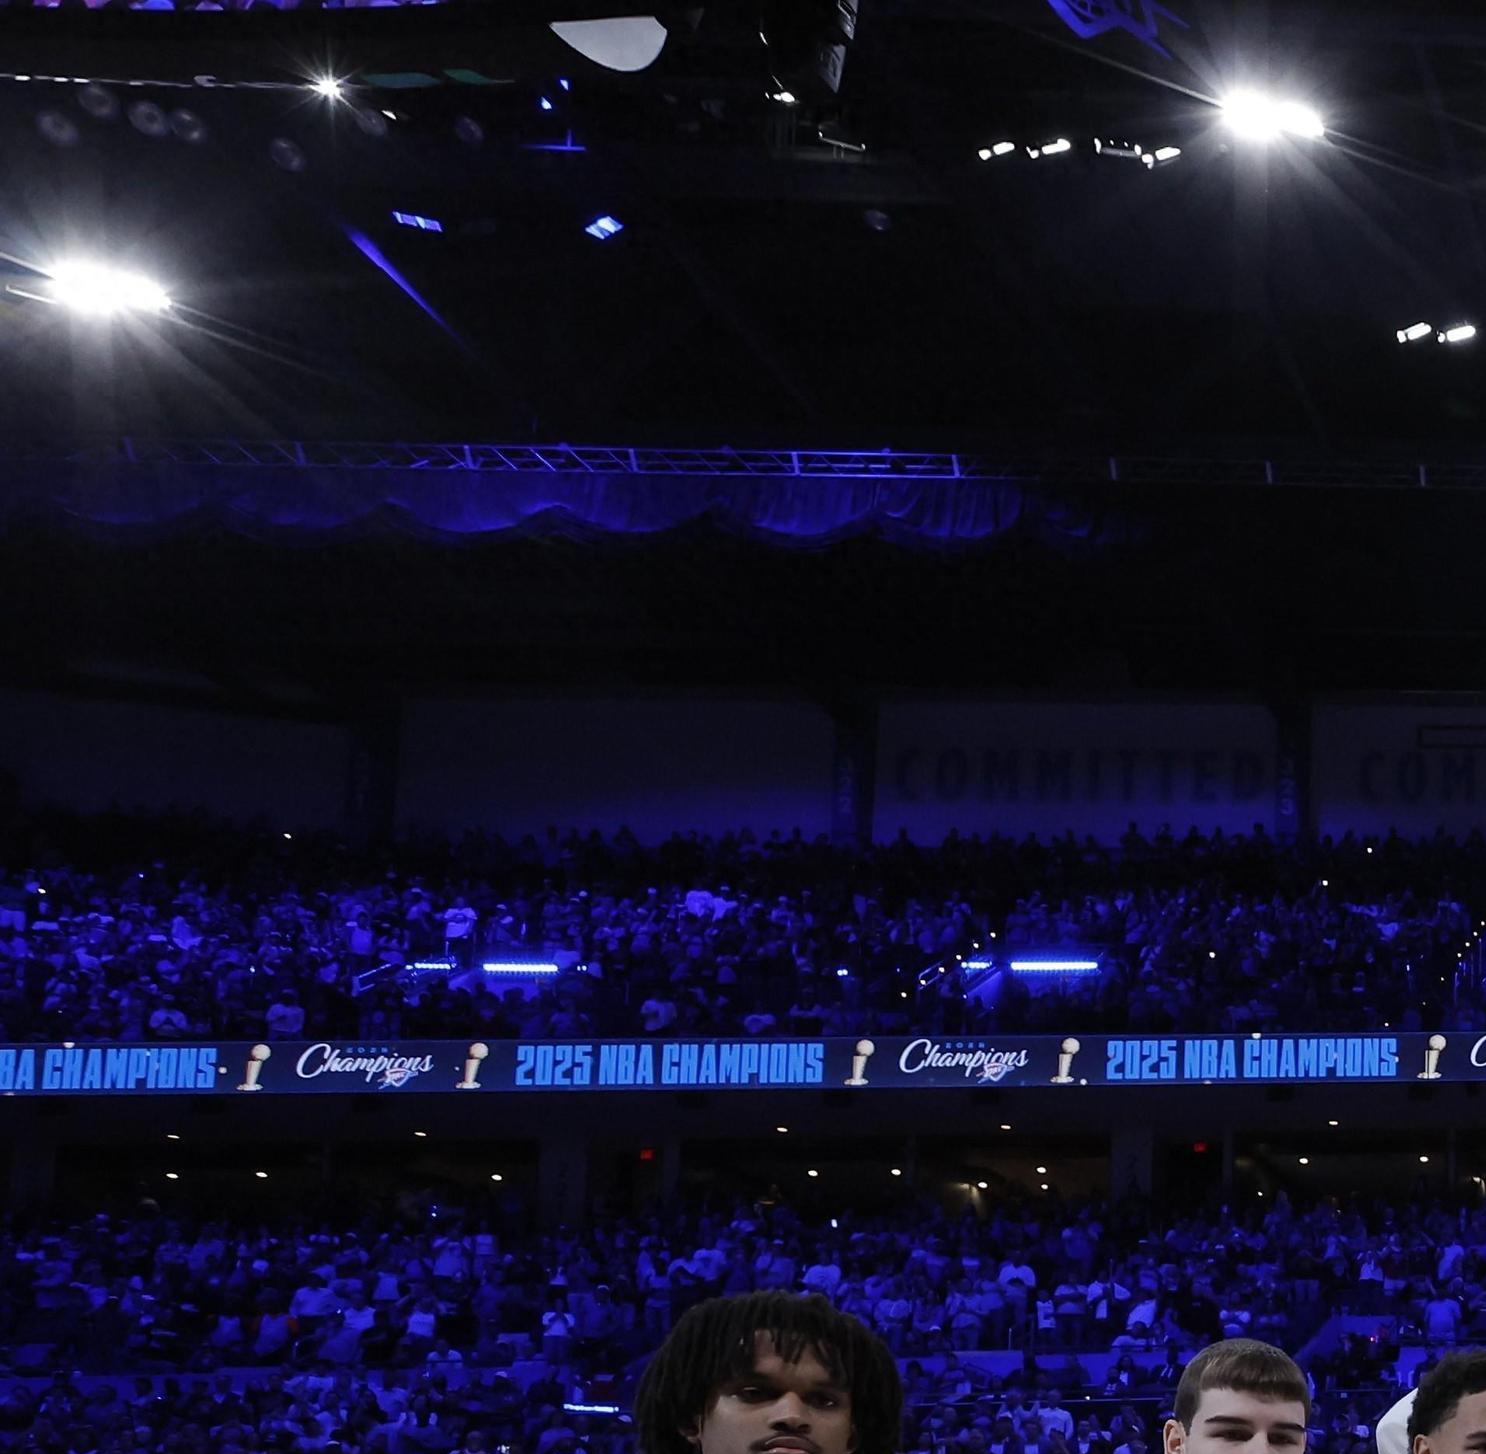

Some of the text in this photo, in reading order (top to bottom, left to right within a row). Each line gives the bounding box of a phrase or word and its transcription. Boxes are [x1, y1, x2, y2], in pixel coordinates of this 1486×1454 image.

[896, 747, 1261, 802] COMMITTED
[42, 1048, 216, 1089] CHAMPIONS
[297, 1043, 434, 1082] Champions
[516, 1043, 823, 1086] 2025 NBA CHAMPIONS
[900, 1038, 1029, 1077] Champions
[1107, 1037, 1397, 1079] 2025 NBA CHAMPIONS
